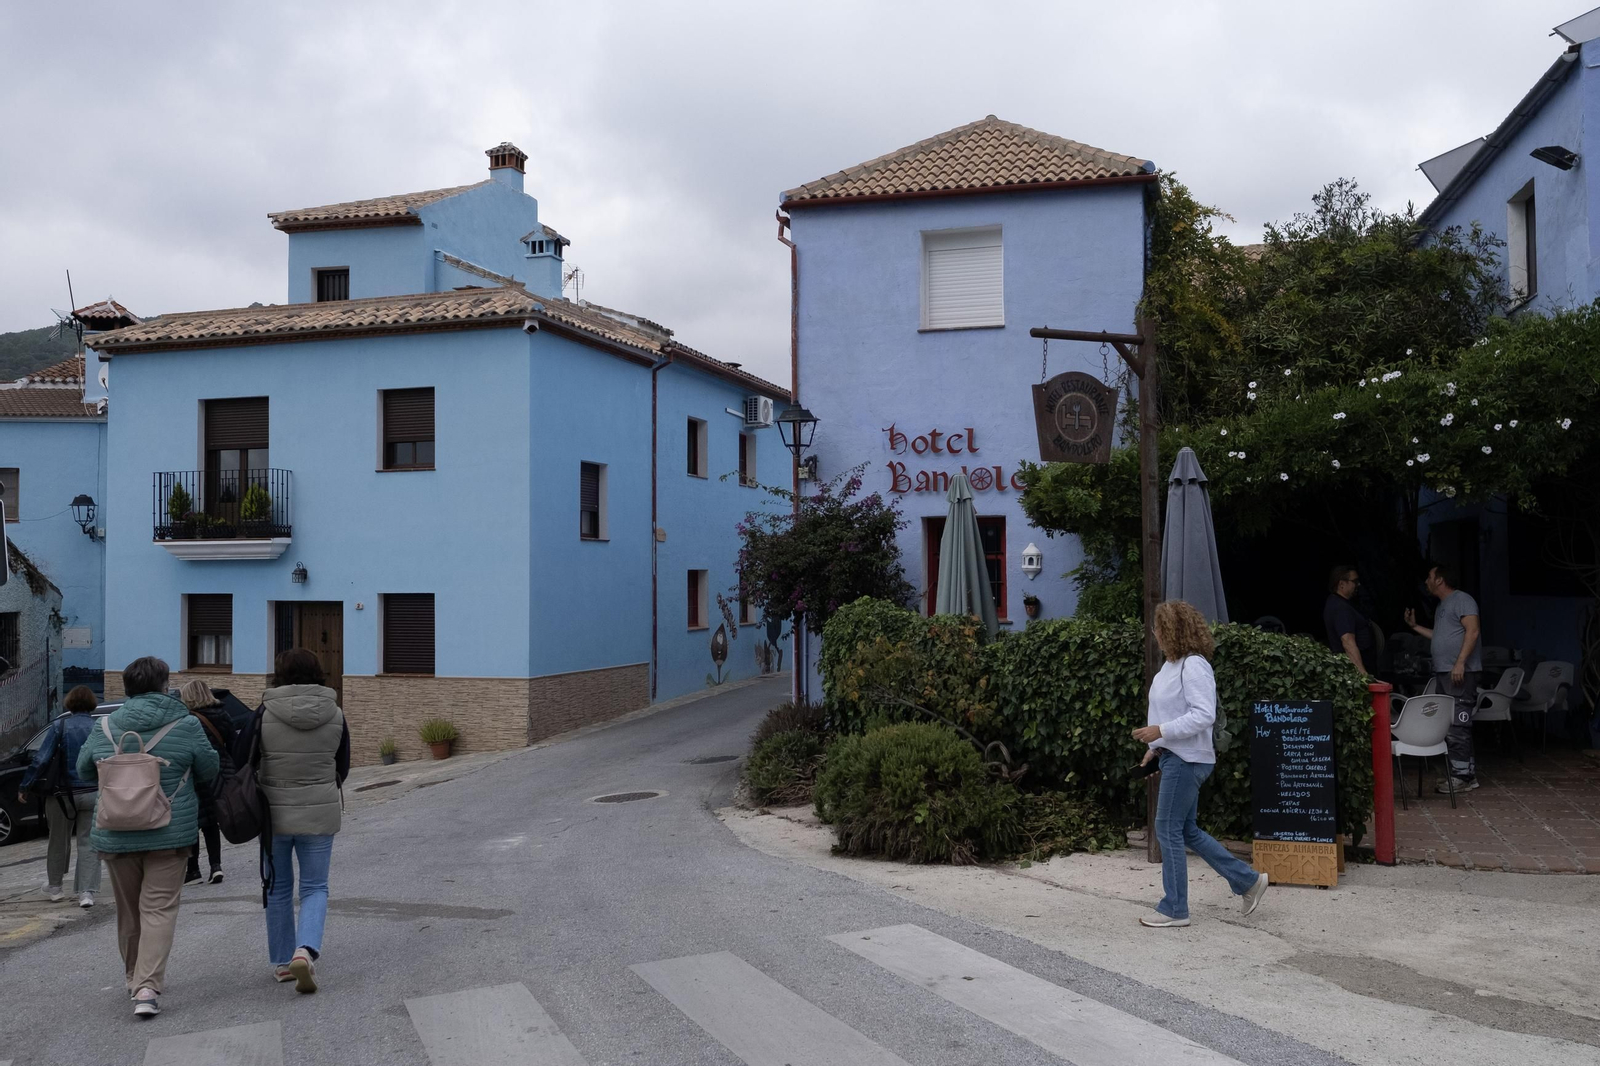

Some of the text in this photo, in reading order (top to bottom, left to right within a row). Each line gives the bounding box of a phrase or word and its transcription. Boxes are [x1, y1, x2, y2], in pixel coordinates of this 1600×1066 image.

[1045, 379, 1110, 416] HOTEL RESTAURANTE
[1254, 842, 1335, 855] CERVEZAS ALHAMBRA
